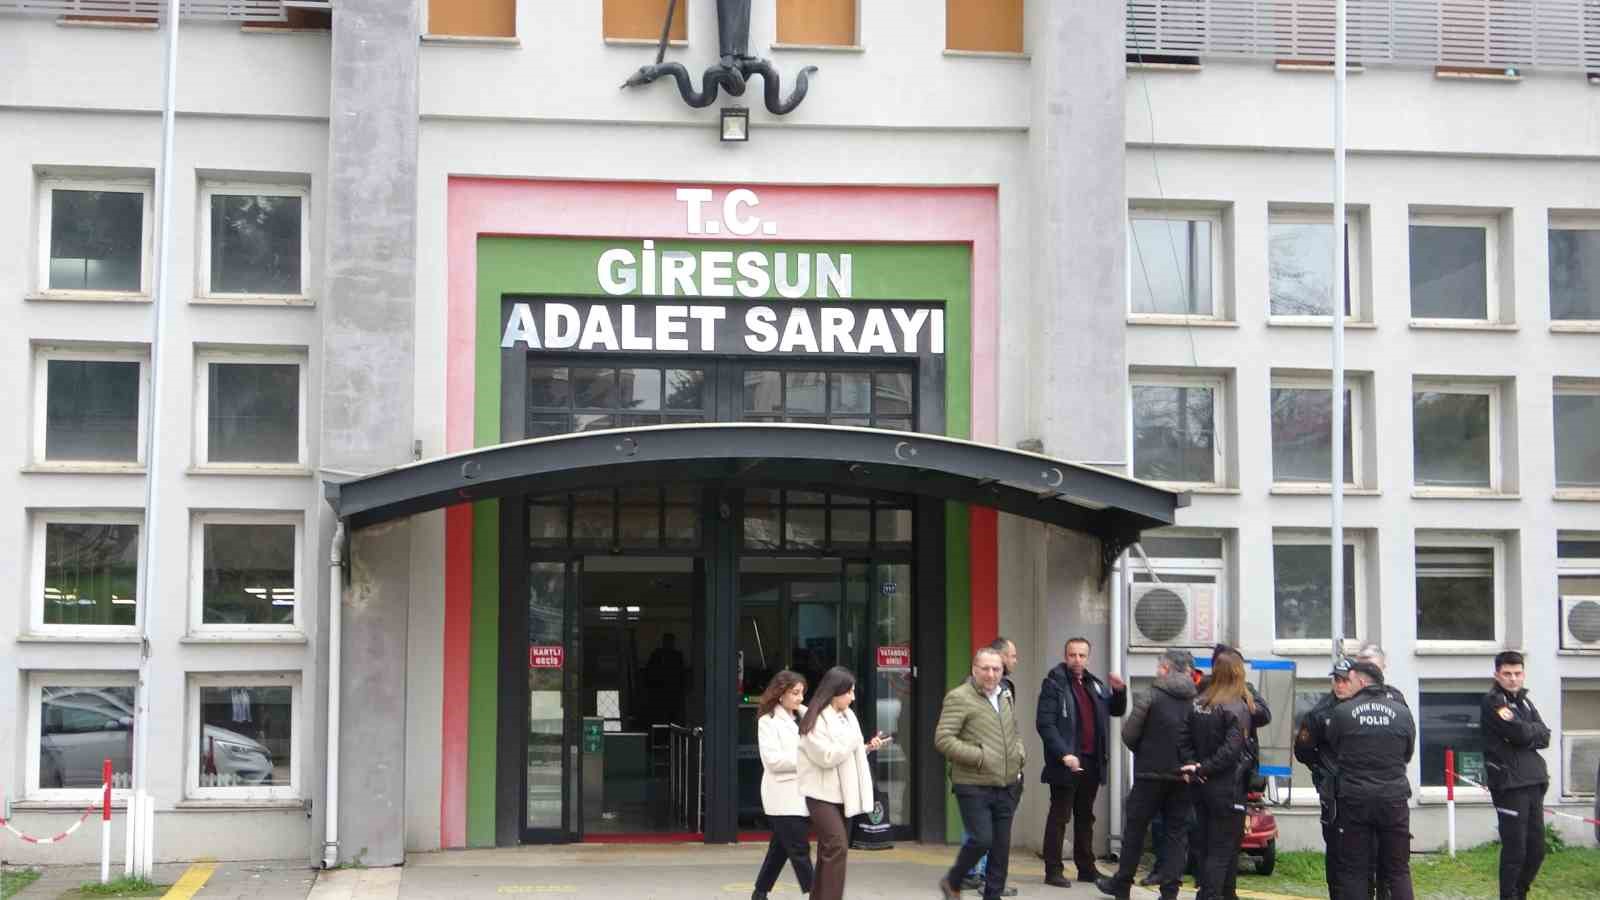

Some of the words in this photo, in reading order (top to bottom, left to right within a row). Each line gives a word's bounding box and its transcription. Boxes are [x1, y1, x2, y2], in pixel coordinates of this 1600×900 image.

[676, 188, 777, 235] T.C.
[597, 240, 853, 298] GİRESUN
[501, 303, 726, 351] ADALET
[744, 307, 945, 354] SARAYI
